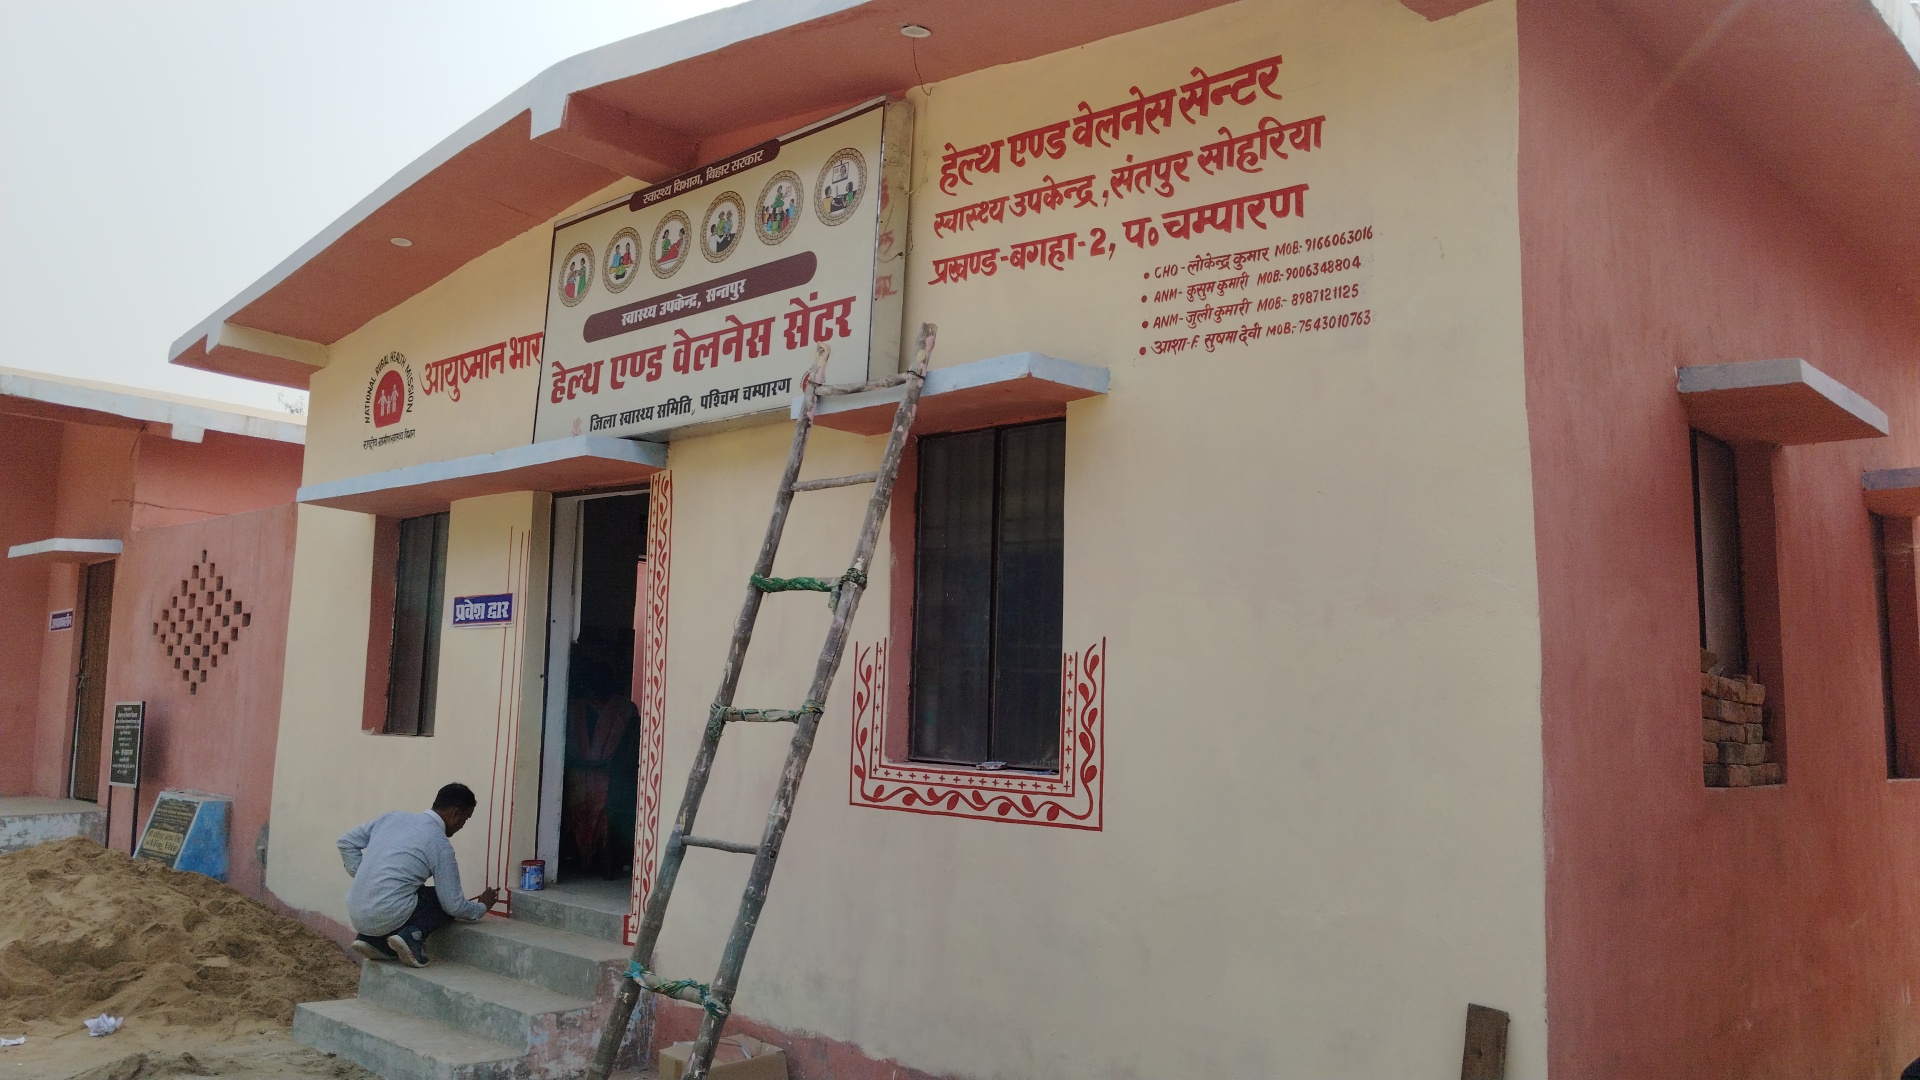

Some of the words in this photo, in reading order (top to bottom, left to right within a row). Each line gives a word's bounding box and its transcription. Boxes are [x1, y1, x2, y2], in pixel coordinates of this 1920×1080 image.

[940, 142, 1006, 196] हेल्थ
[1007, 120, 1073, 168] एण्ड
[1073, 86, 1179, 149] वेलनेस
[1179, 55, 1283, 124] सेन्टर
[643, 185, 672, 205] स्वास्थ्य
[673, 174, 704, 194] विभाग,
[706, 166, 730, 182] बिहार
[731, 149, 765, 172] सरकार
[934, 196, 1010, 239] स्वास्थ्य
[1197, 115, 1326, 173] सोहरिया
[1161, 183, 1310, 240] चम्पारण
[1233, 247, 1270, 270] कुमार
[621, 304, 658, 326] स्वास्थ्य
[706, 278, 747, 301] सन्तपुर
[1186, 281, 1217, 302] कुसुम
[1217, 271, 1250, 297] कुमारी
[1186, 303, 1214, 329] जुली
[1214, 298, 1253, 323] कुमारी
[1291, 283, 1359, 306] 8987121125
[550, 360, 605, 405] हेल्थ
[610, 344, 667, 390] एण्ड
[673, 314, 776, 376] वेलनेस
[783, 291, 857, 351] सेंटर
[1204, 330, 1239, 353] सुषमा
[1239, 322, 1263, 346] देवी
[364, 377, 377, 424] NATIONAL
[375, 354, 389, 376] RURAL
[389, 350, 407, 368] HEALTH
[405, 363, 415, 413] MISSION
[419, 341, 507, 403] आयुष्मान
[509, 331, 544, 369] भार
[590, 414, 618, 432] जिला
[619, 406, 655, 426] स्वास्थ्य
[700, 388, 741, 410] पश्चिम
[742, 377, 792, 401] चम्पारण
[454, 599, 486, 622] प्रवेश
[487, 601, 510, 619] द्वार
